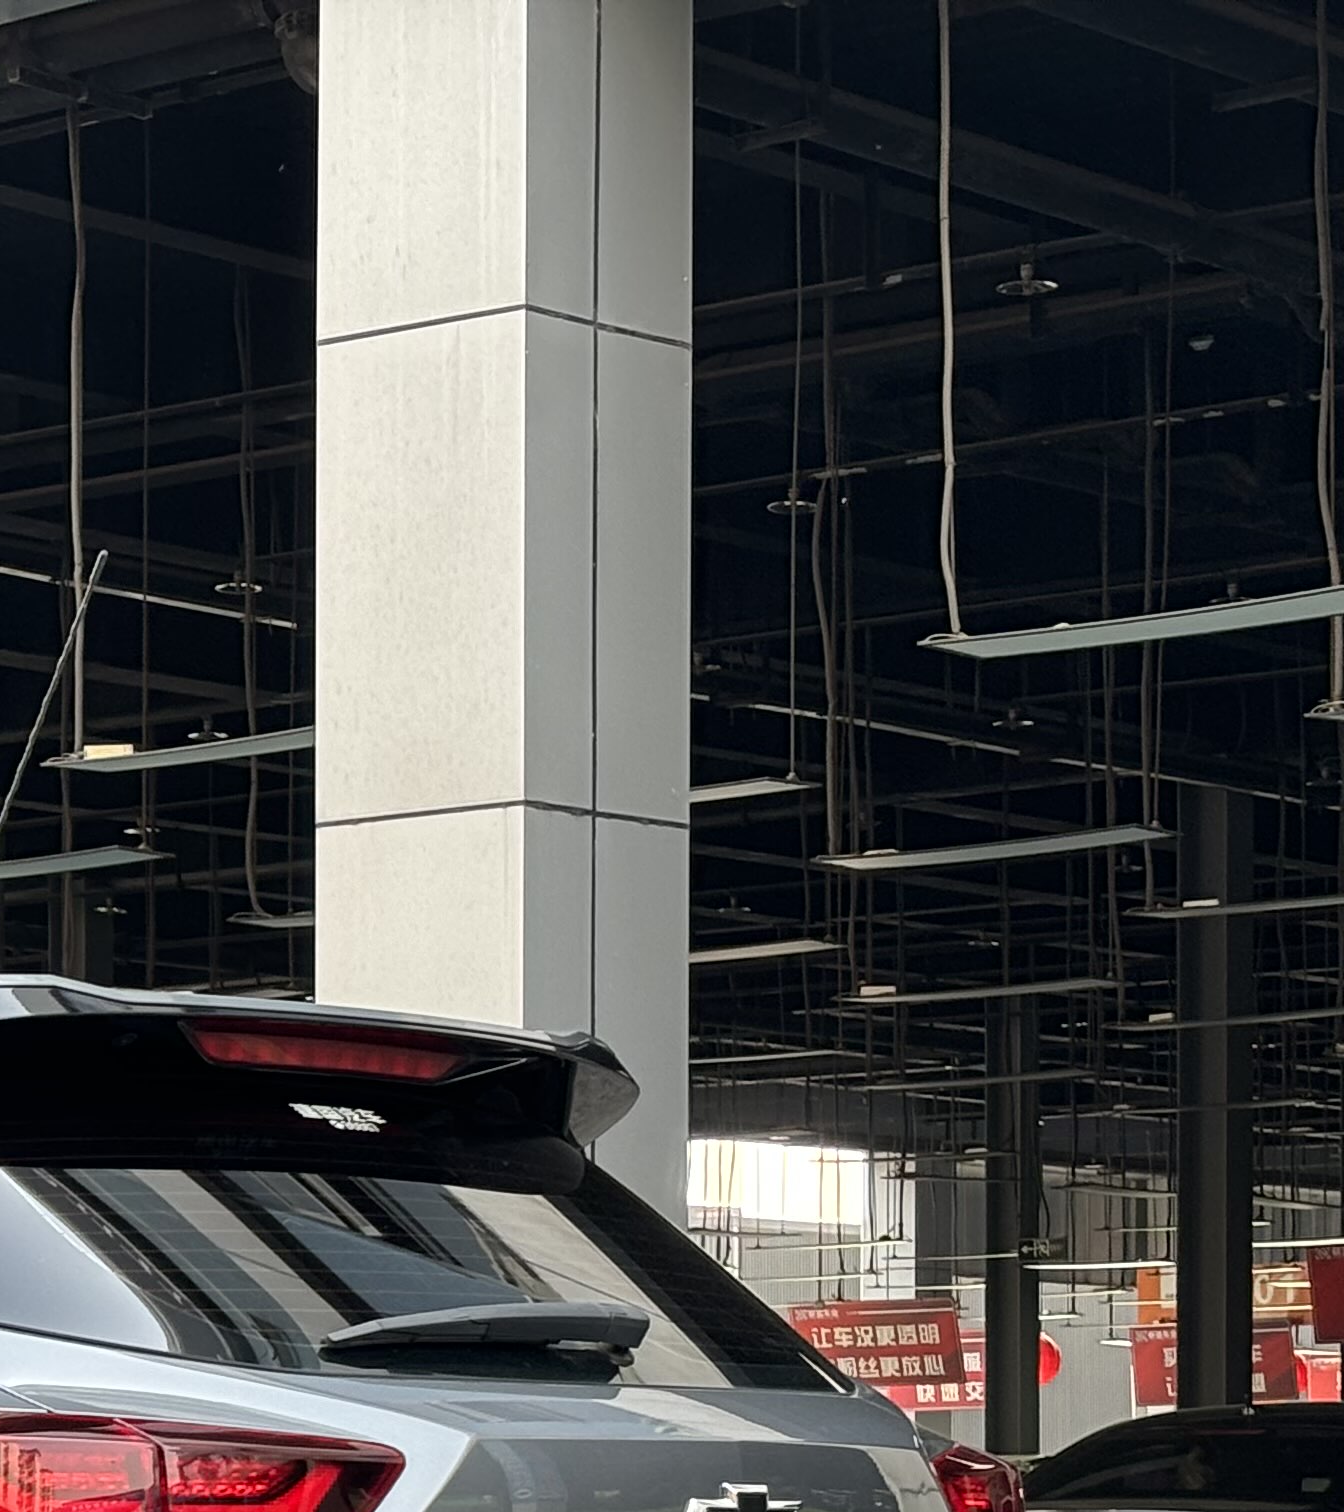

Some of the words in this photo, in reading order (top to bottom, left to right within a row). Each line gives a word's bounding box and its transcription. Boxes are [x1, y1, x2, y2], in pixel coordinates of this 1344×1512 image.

[829, 1354, 946, 1378] 粉丝更放心
